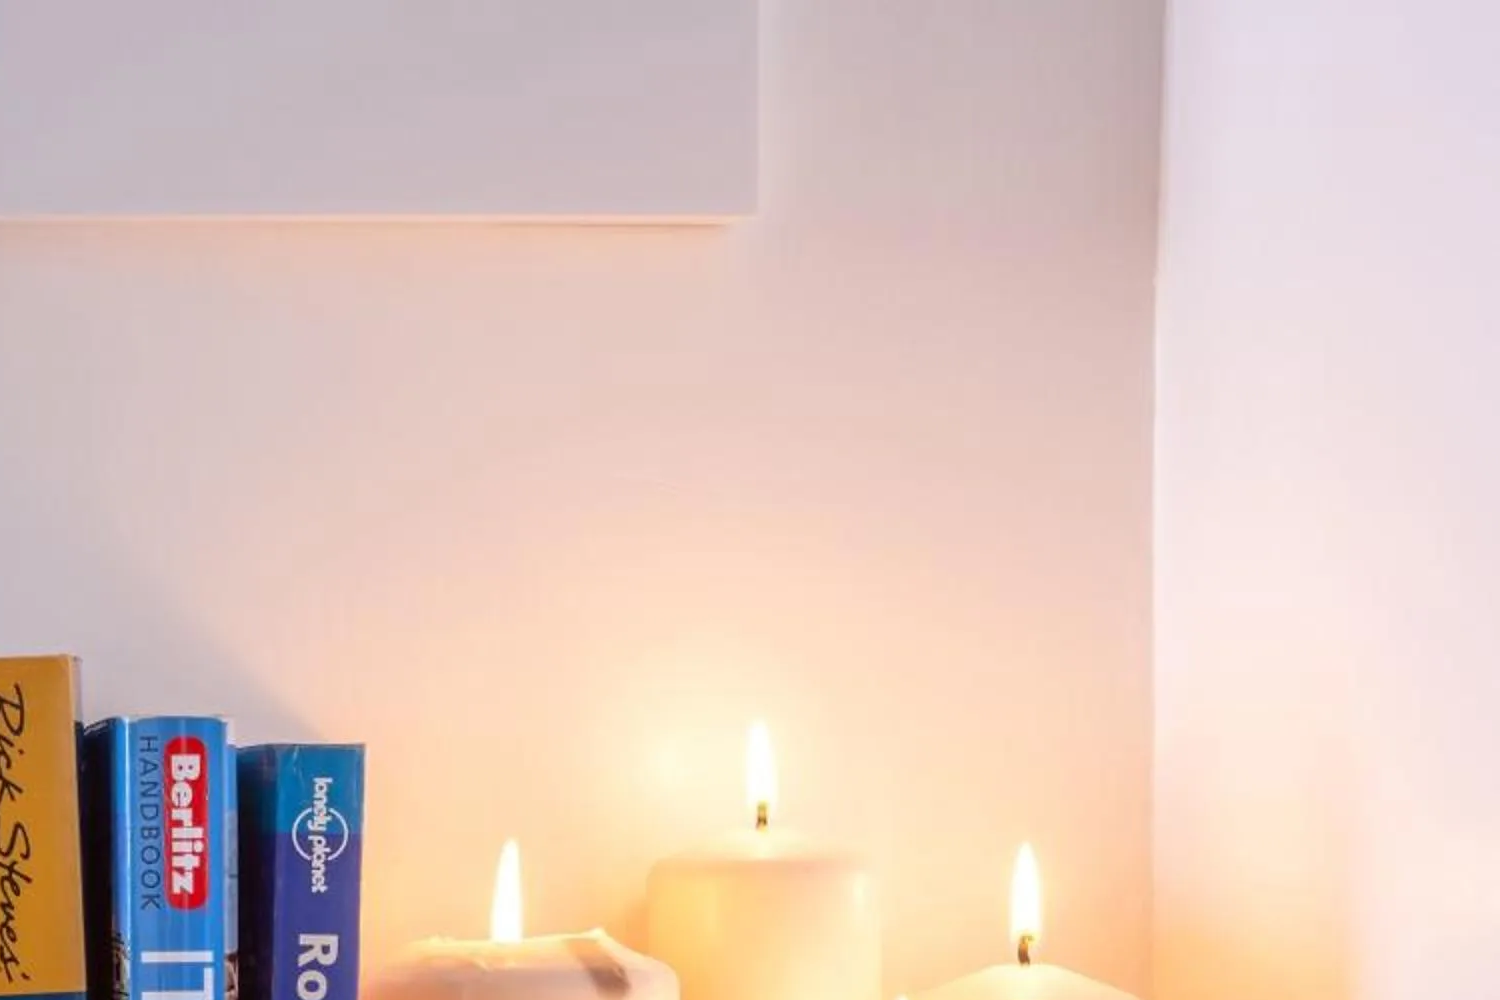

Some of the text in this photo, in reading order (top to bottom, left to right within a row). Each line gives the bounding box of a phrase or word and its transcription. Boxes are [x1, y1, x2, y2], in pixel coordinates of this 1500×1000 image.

[138, 734, 163, 911] HANDBOOK
[169, 753, 203, 896] Berlitz
[307, 777, 333, 893] lonely planet
